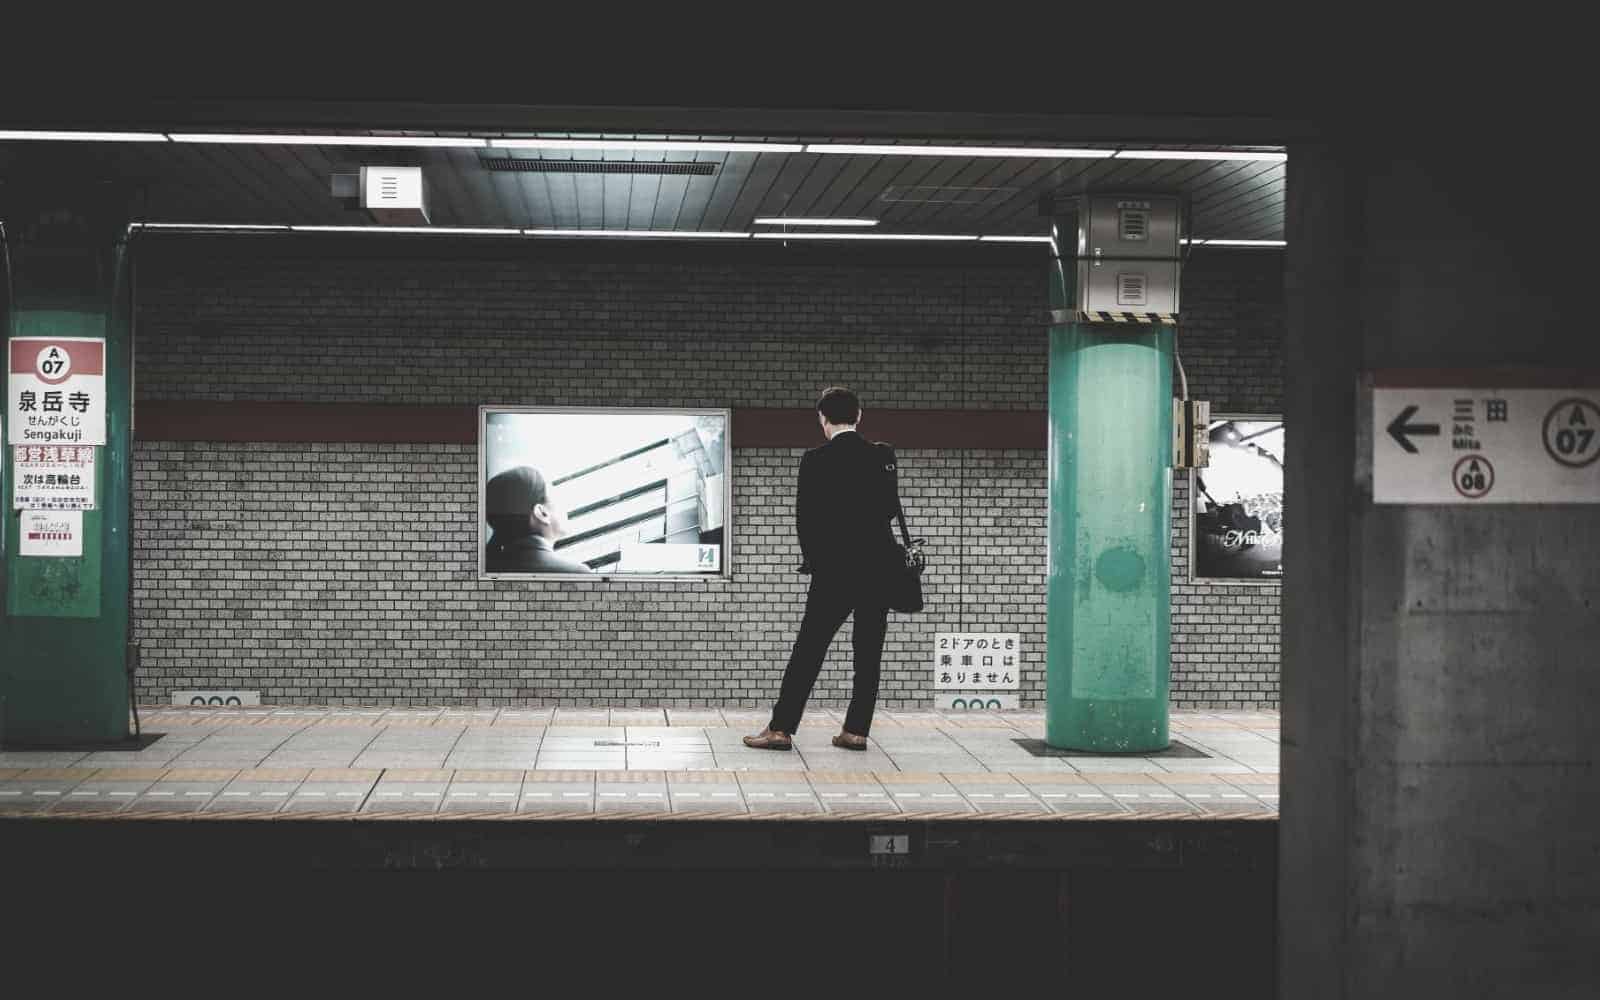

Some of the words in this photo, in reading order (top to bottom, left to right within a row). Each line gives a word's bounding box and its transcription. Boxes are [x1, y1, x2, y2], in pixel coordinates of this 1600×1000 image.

[49, 348, 59, 358] A
[42, 361, 64, 374] 07
[19, 390, 90, 413] 泉岳寺
[1453, 399, 1508, 422] 三田
[1569, 405, 1587, 427] A
[28, 416, 80, 426] せんがくじ
[24, 429, 82, 442] Sengakuji
[1556, 429, 1595, 454] 07
[1469, 459, 1480, 472] A
[1461, 475, 1485, 490] 08
[940, 637, 1014, 650] 2ドアのとき
[940, 672, 1014, 683] ありません
[886, 837, 896, 853] 4
